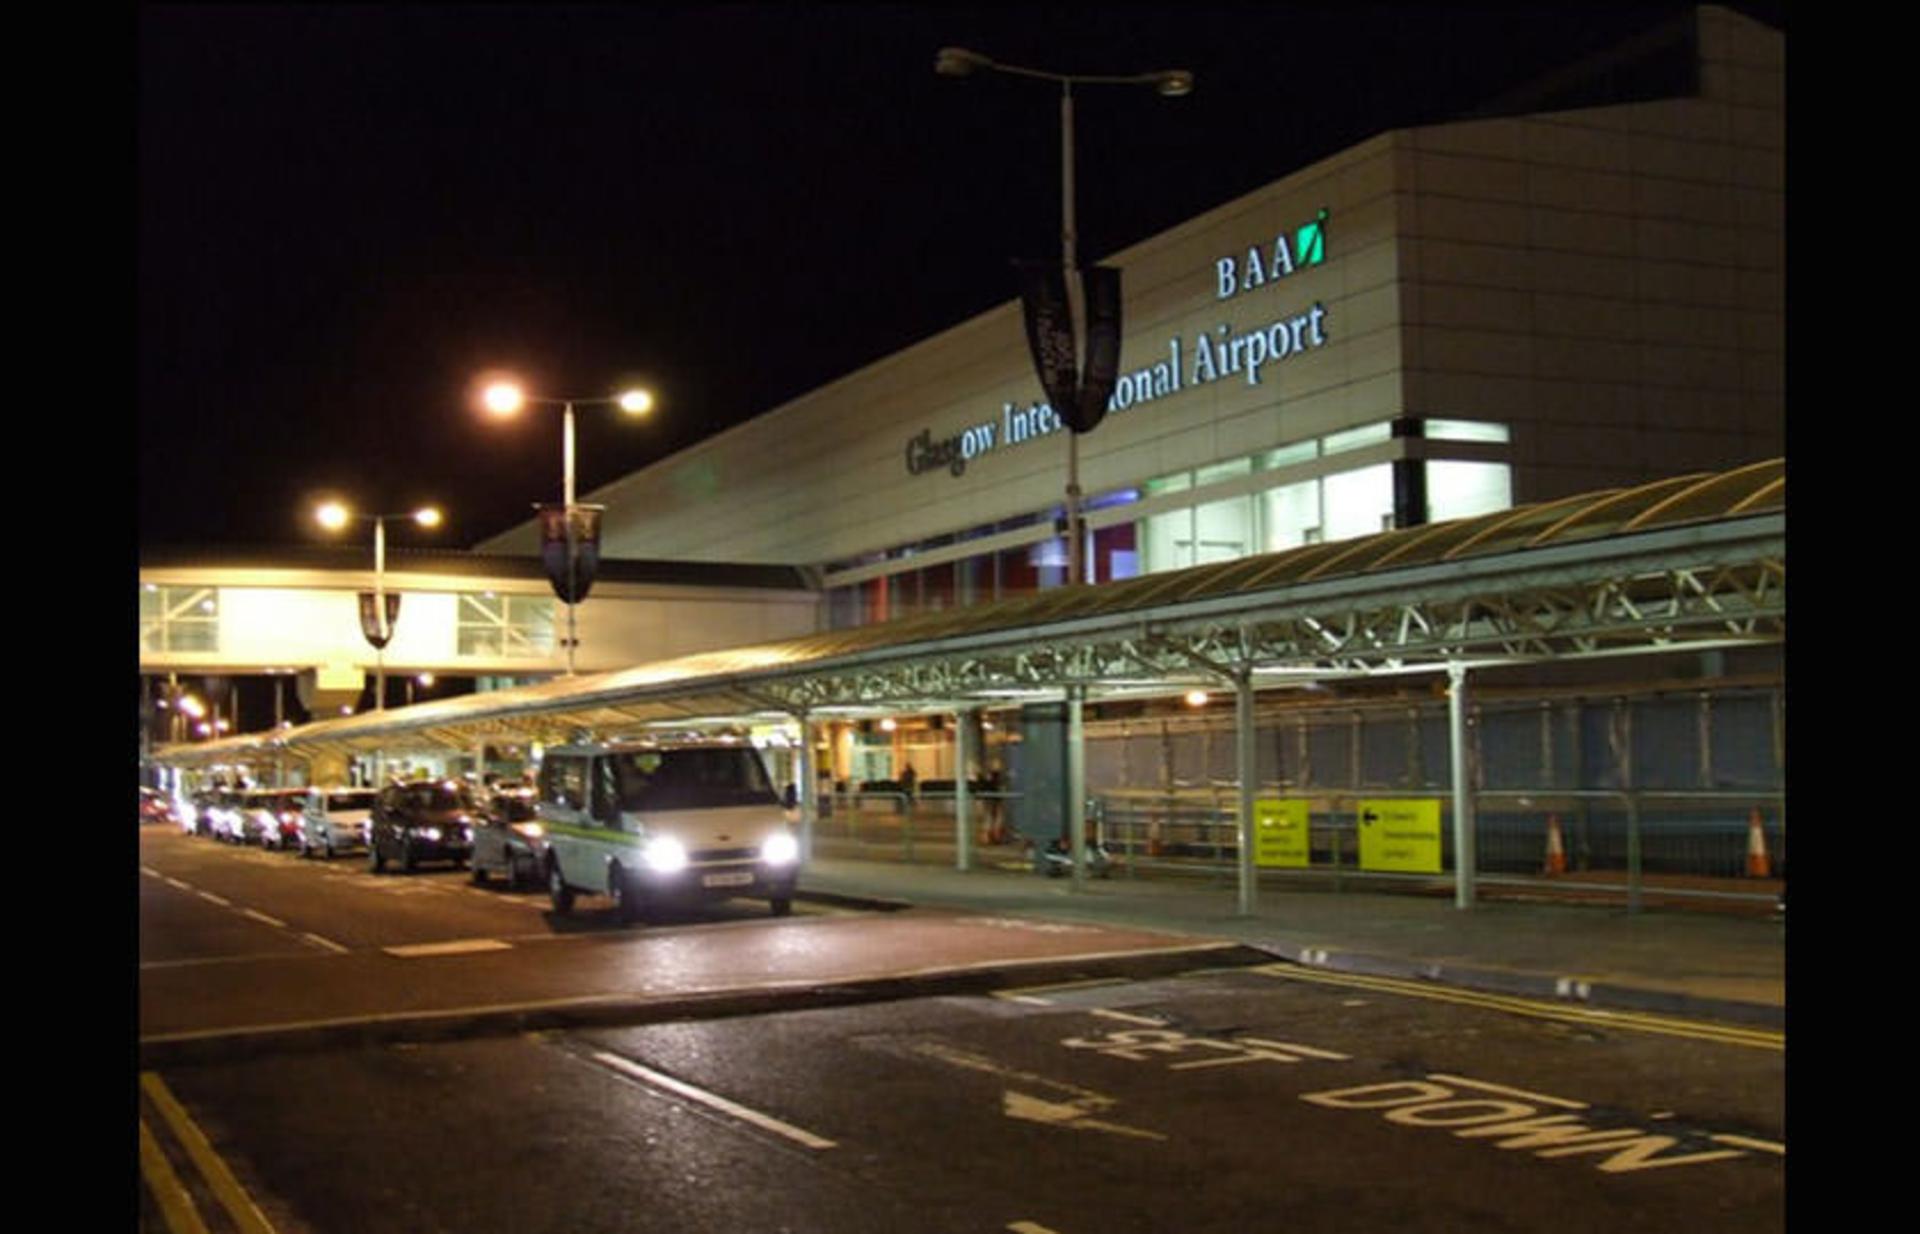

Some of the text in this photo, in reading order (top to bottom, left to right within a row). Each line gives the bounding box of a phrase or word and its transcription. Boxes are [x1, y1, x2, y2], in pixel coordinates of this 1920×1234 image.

[1216, 234, 1296, 300] BAA
[906, 421, 998, 479] Glasgow
[1003, 338, 1182, 445] Inteonal
[1192, 302, 1327, 384] Airport
[1060, 1028, 1304, 1070] SET
[1298, 1080, 1750, 1174] DOWN
